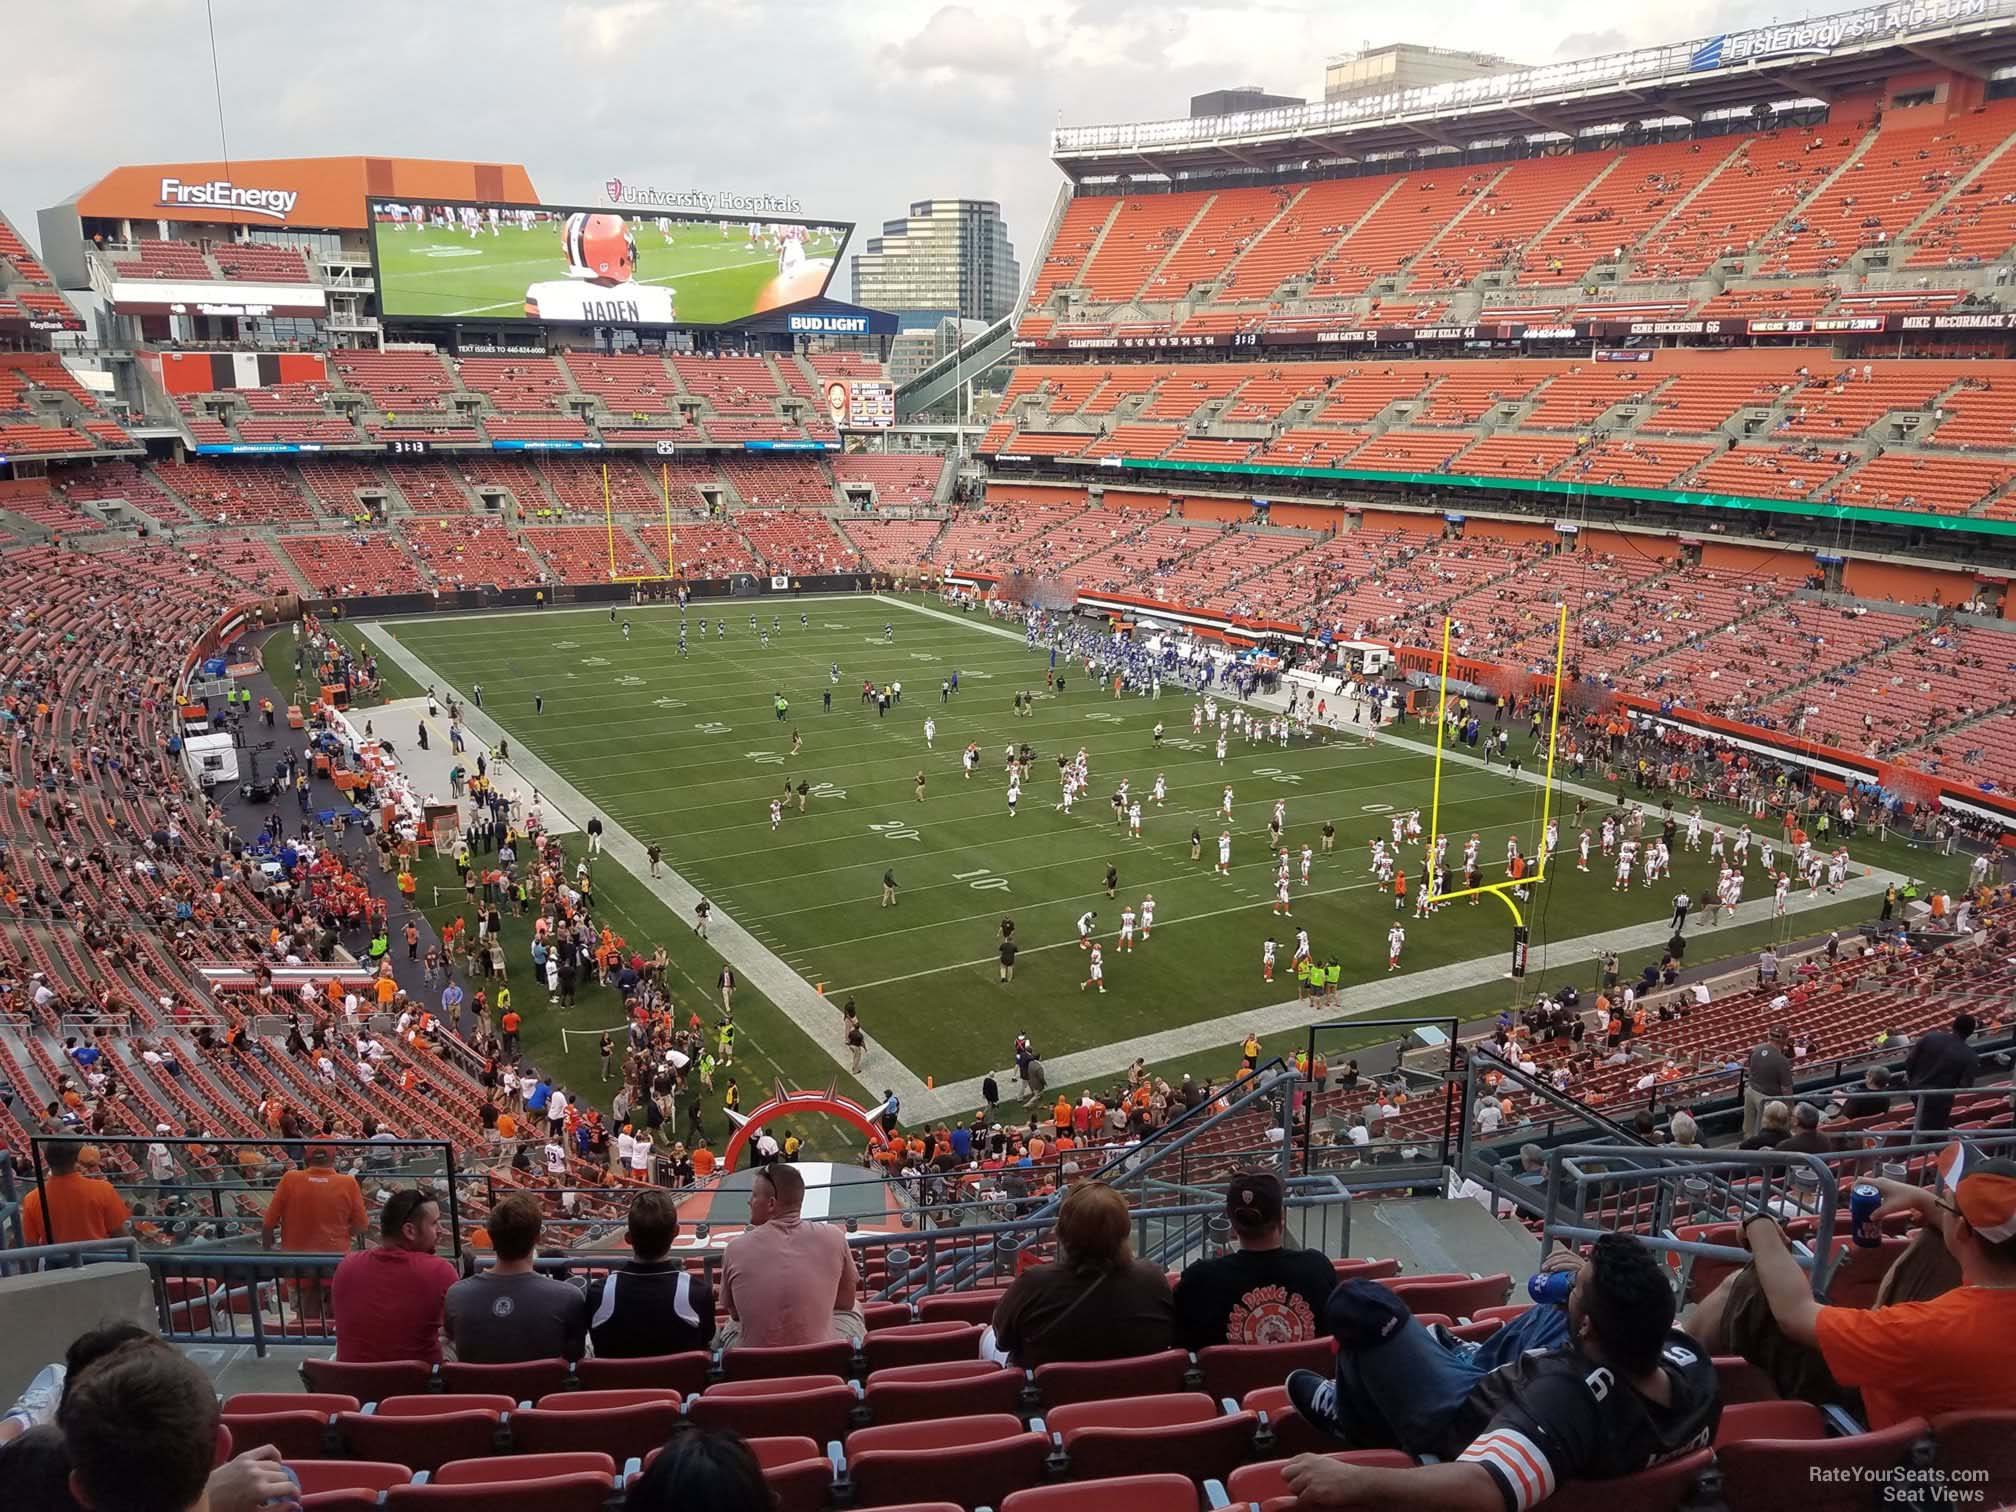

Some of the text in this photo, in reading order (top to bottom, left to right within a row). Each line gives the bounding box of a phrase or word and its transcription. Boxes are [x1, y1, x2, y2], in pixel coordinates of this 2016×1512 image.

[1729, 0, 1986, 58] FirstEnergy STADIUM
[160, 178, 297, 212] FirstEnergy
[623, 187, 716, 211] University
[719, 192, 801, 214] Hospitals
[582, 301, 639, 321] HADEN
[29, 321, 64, 330] KeyBank
[790, 317, 866, 331] BUD LIGHT
[1630, 320, 1720, 333] GENE HICKERSON 66
[1902, 313, 2016, 328] MIKE McCORMACK 7
[1317, 331, 1340, 341] FRANK
[1366, 330, 1377, 341] 52
[1415, 327, 1475, 338] LEROY KELLY 44
[458, 345, 474, 353] TEXT
[475, 345, 495, 353] ISSUES
[497, 345, 505, 353] TO
[1011, 340, 1036, 348] KeyBank
[1068, 339, 1118, 348] CHAMPIONSHIPS
[1400, 652, 1433, 674] HOME
[1456, 663, 1480, 685] THE
[745, 752, 784, 764] 40
[867, 820, 920, 840] 20
[952, 868, 1009, 890] 10
[975, 1129, 987, 1141] 77
[547, 1151, 557, 1164] 13
[1241, 1284, 1288, 1310] DAWG
